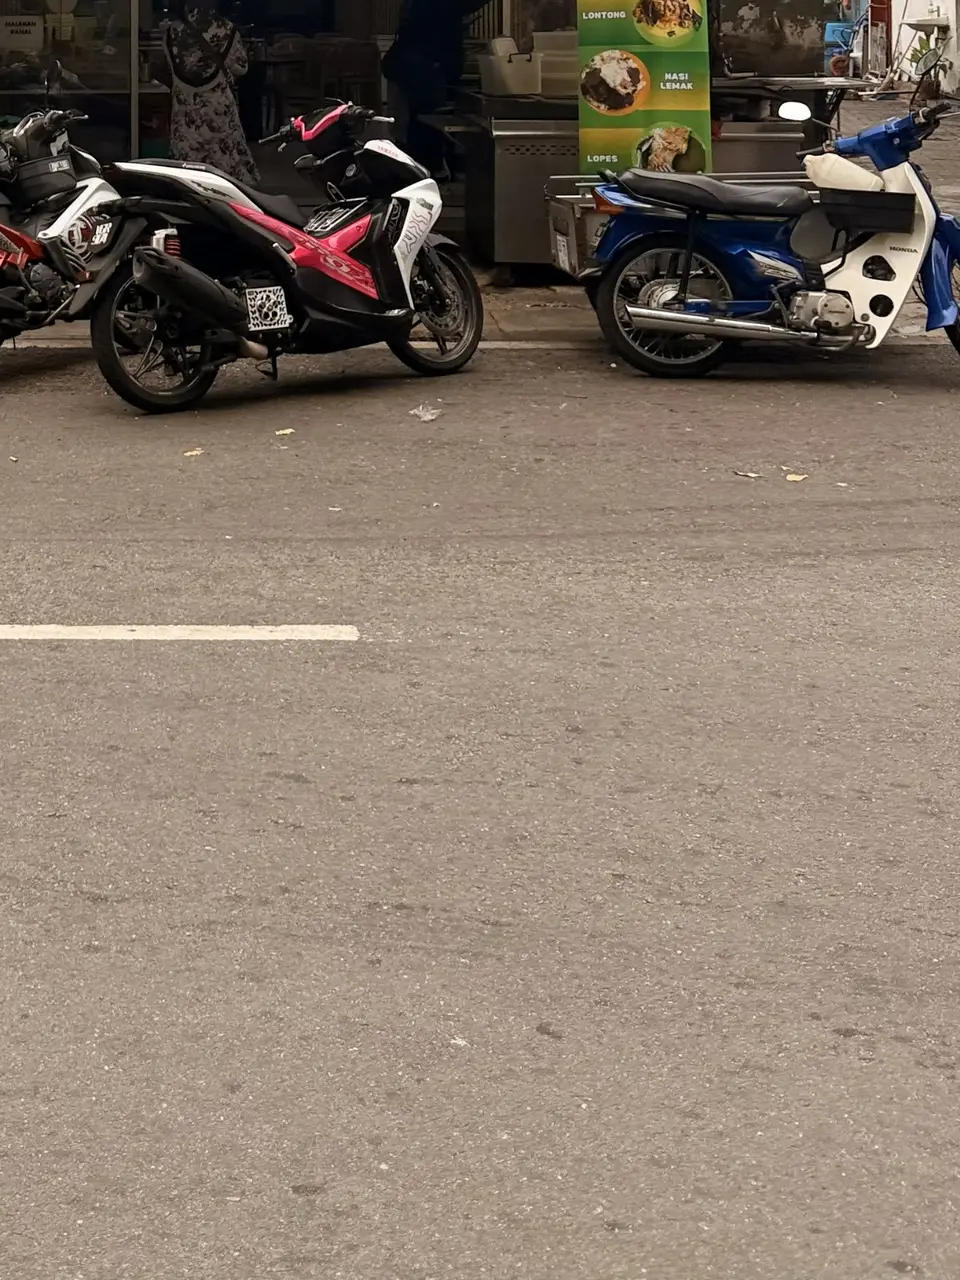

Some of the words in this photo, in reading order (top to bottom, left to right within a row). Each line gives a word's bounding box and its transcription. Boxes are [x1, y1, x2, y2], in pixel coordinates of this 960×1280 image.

[582, 11, 626, 20] LONTONG
[665, 72, 688, 81] NASI
[660, 81, 693, 90] LEMAK
[587, 155, 618, 163] LOPES
[889, 246, 918, 254] HONDA
